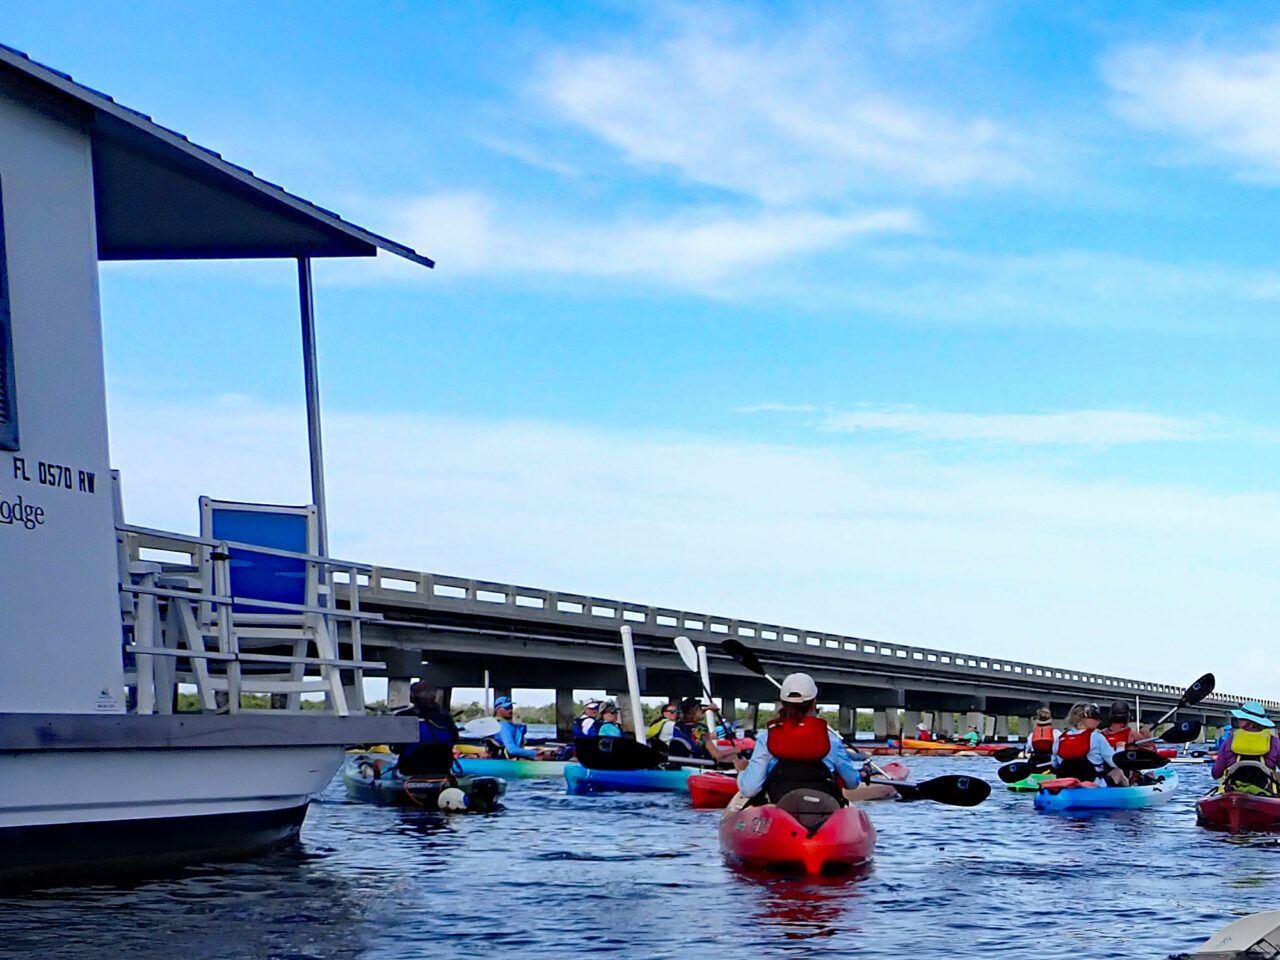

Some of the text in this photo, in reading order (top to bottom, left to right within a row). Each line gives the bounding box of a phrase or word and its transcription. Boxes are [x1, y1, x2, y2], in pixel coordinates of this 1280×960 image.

[13, 456, 95, 494] FL 0570 RW
